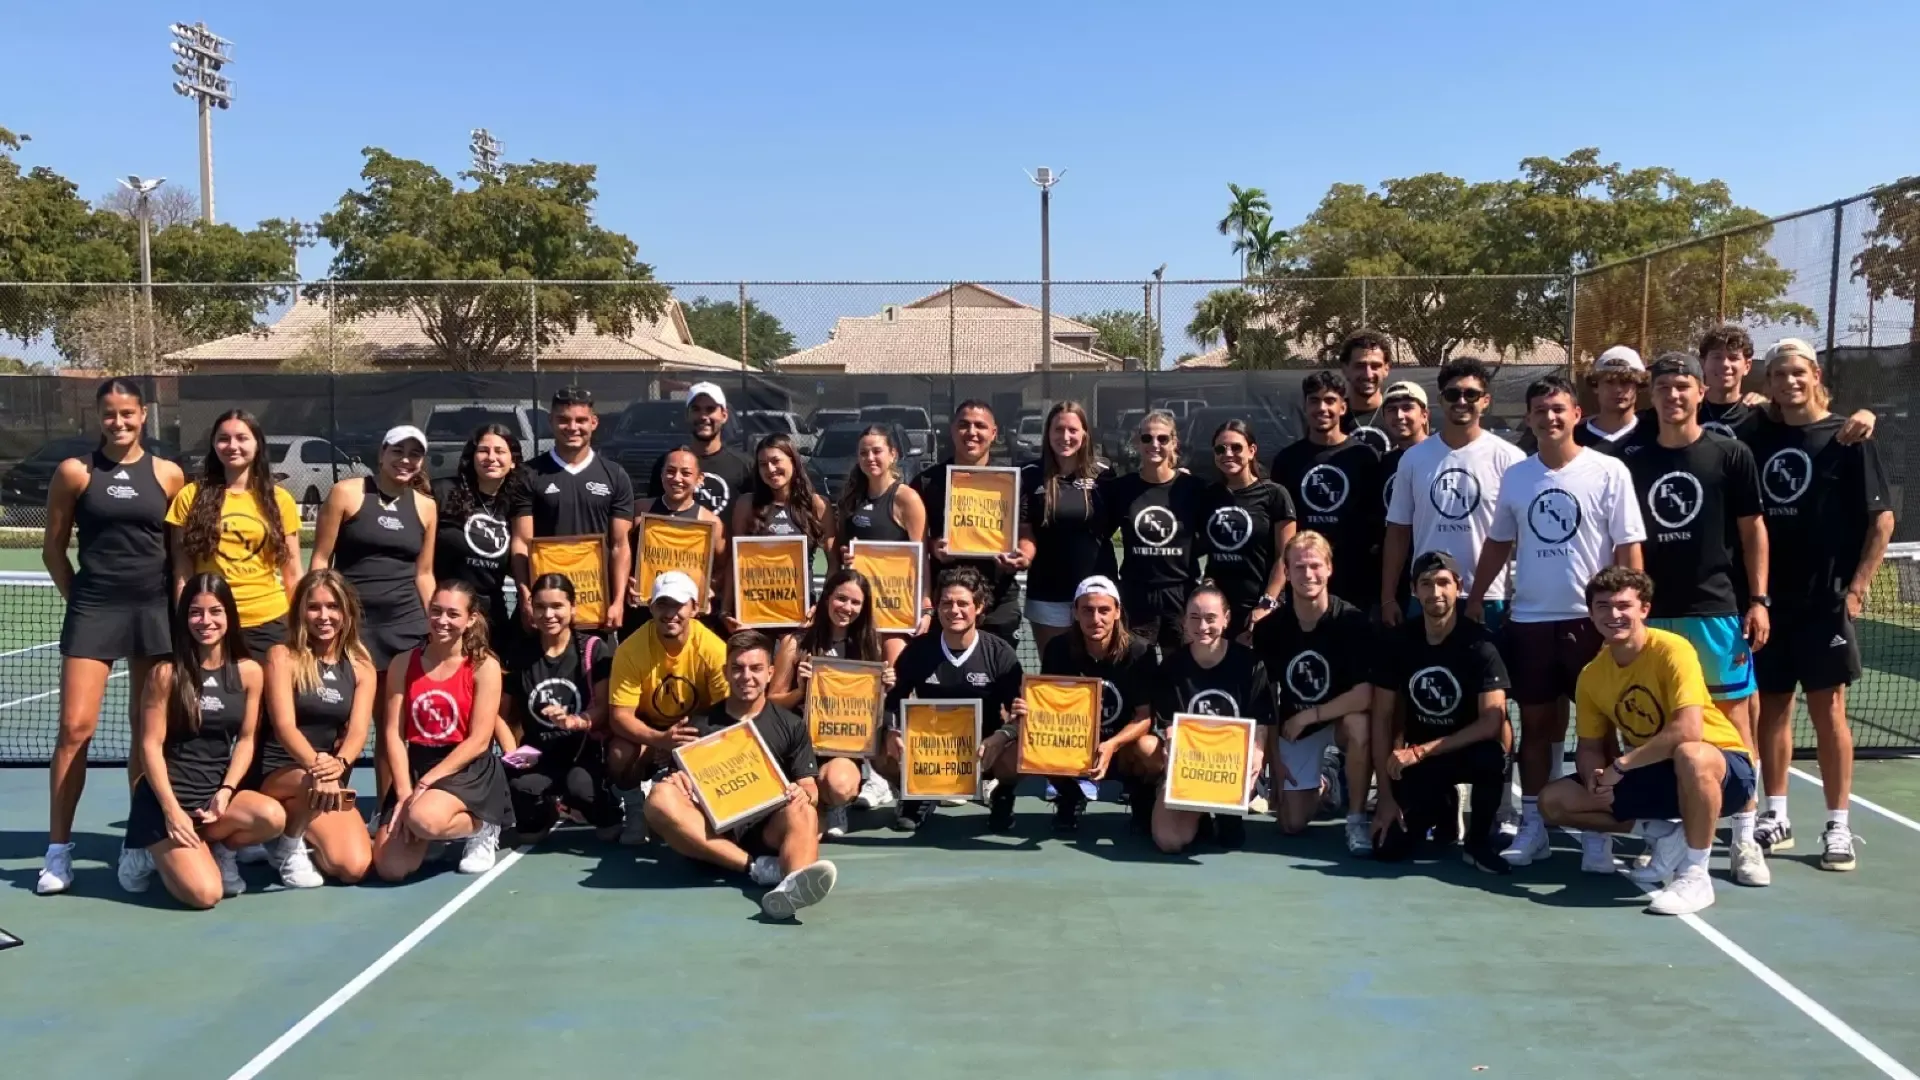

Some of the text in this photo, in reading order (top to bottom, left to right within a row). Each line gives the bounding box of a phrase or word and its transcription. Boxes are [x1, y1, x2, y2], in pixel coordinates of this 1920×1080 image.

[885, 306, 893, 321] 1
[1311, 473, 1341, 503] FNU
[1660, 483, 1693, 515] FNU
[953, 514, 1004, 531] CASTILLO
[1307, 515, 1339, 523] TENNIS
[1538, 499, 1573, 532] FNU
[1144, 513, 1171, 538] FNU
[1216, 513, 1244, 542] FNU
[1436, 523, 1472, 533] TENNIS
[1657, 531, 1692, 543] TENNIS
[1132, 546, 1183, 556] ATHLETICS
[1213, 553, 1243, 562] TENNIS
[1536, 548, 1575, 559] TENNIS
[466, 557, 500, 569] TENNIS
[743, 588, 797, 602] MESTANZA
[875, 596, 901, 610] ABAD
[1420, 676, 1454, 708] FNU
[421, 698, 452, 730] FNU
[1417, 714, 1455, 725] TENNIS
[1028, 732, 1087, 748] STEFANACCI
[913, 761, 973, 776] GARCIA-PRADO
[1181, 766, 1237, 784] CORDERO
[714, 771, 760, 798] ACOSTA
